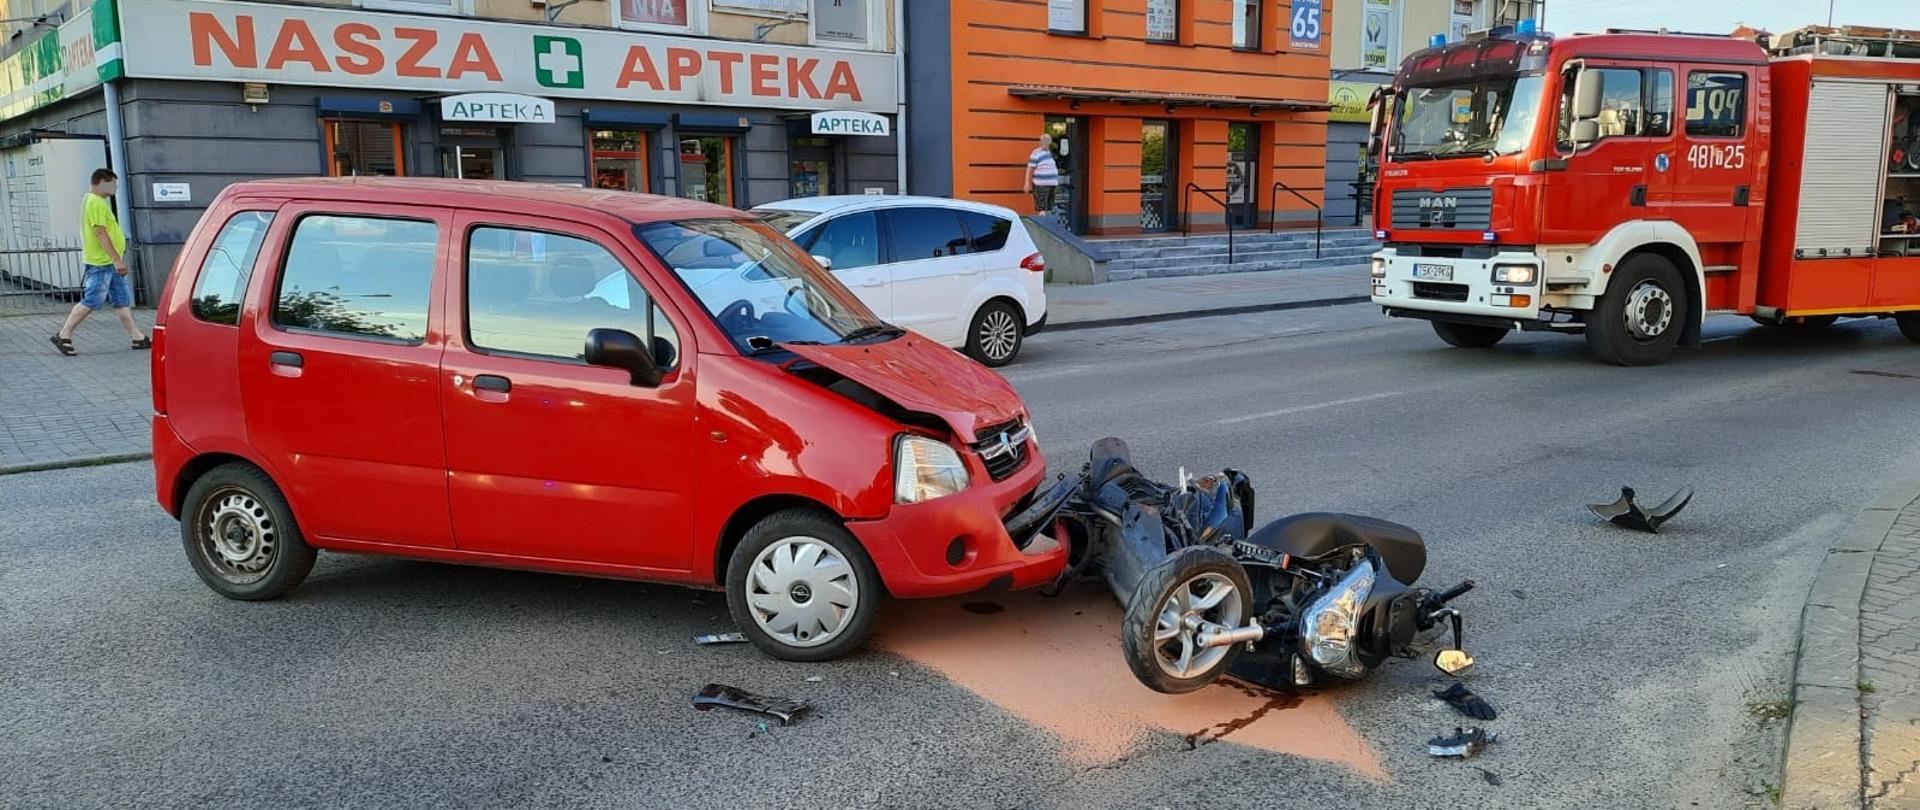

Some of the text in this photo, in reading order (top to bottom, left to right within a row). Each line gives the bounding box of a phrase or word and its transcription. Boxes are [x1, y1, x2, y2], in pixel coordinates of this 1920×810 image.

[1292, 6, 1320, 39] 65
[189, 12, 863, 102] NASZA APTEKA
[452, 101, 545, 120] APTEKA
[817, 117, 885, 133] APTEKA
[1419, 197, 1457, 208] MAN
